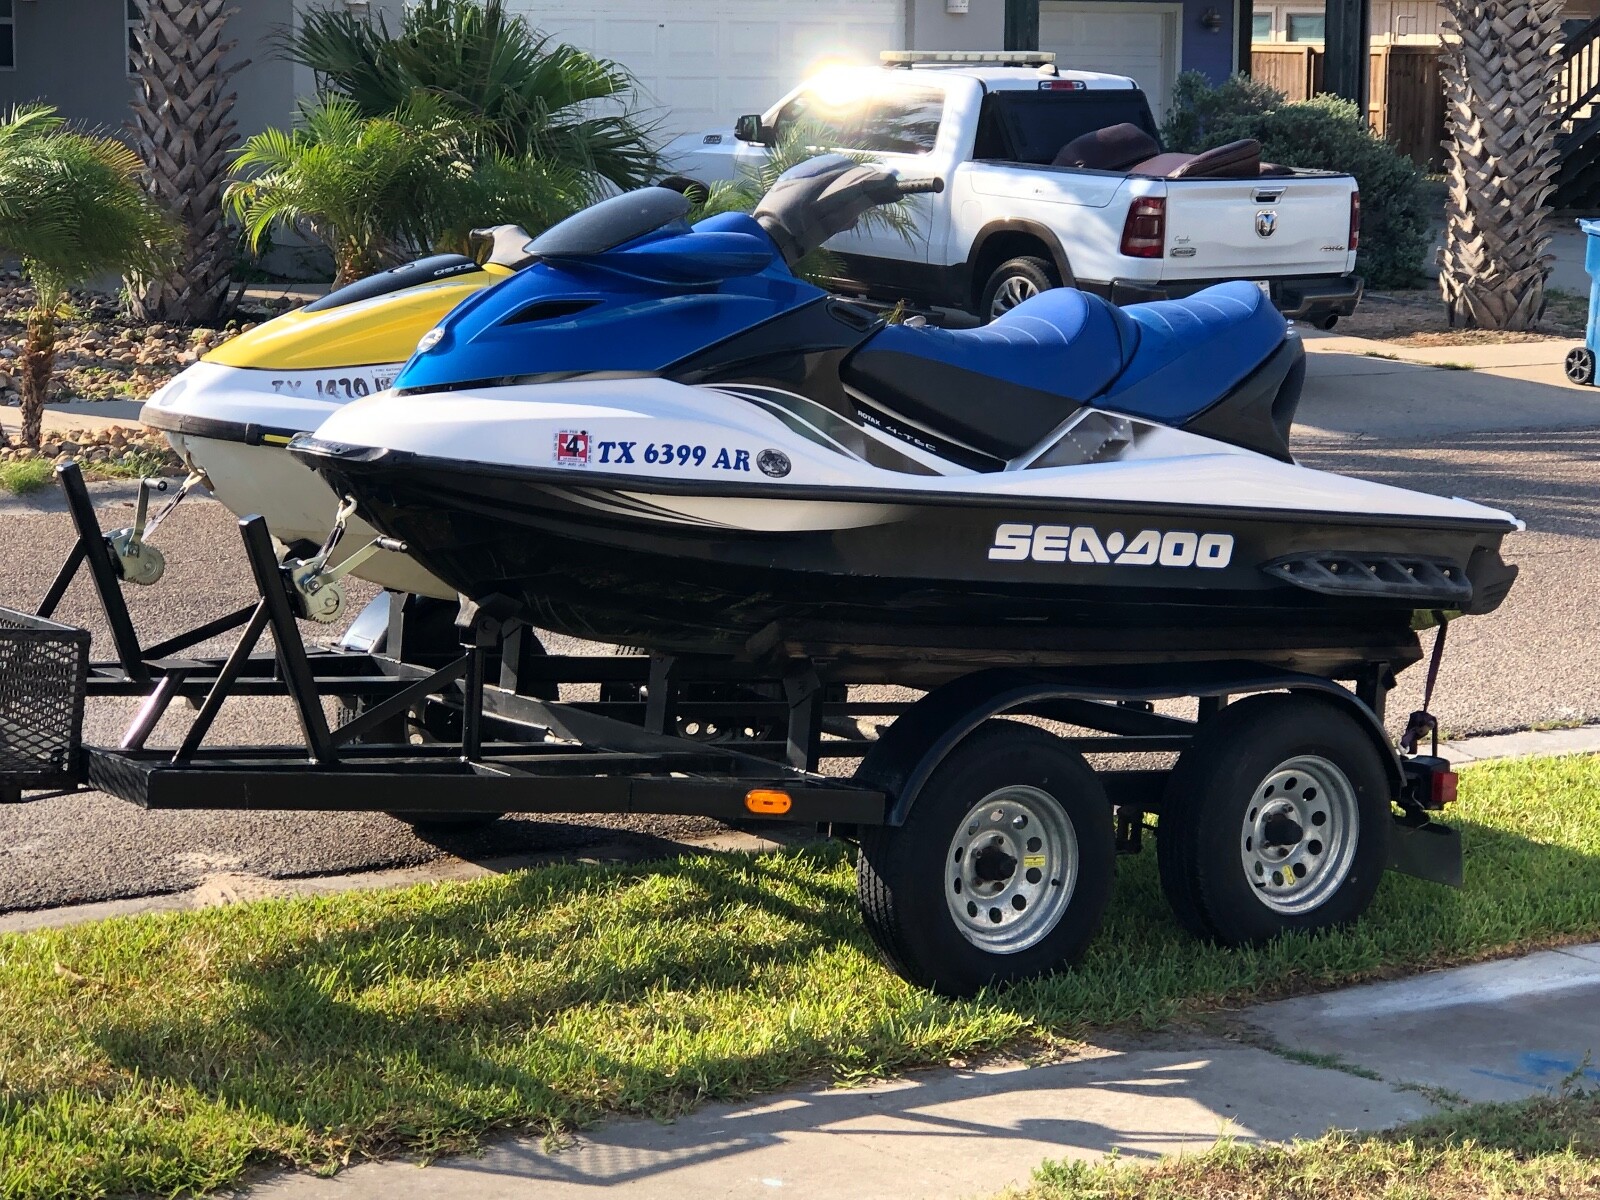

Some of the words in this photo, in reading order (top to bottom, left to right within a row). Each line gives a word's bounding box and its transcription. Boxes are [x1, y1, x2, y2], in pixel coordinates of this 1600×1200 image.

[857, 409, 881, 427] ROTAX
[565, 434, 580, 457] 4
[597, 441, 637, 464] TX
[643, 443, 707, 467] 6399
[711, 447, 751, 472] AR
